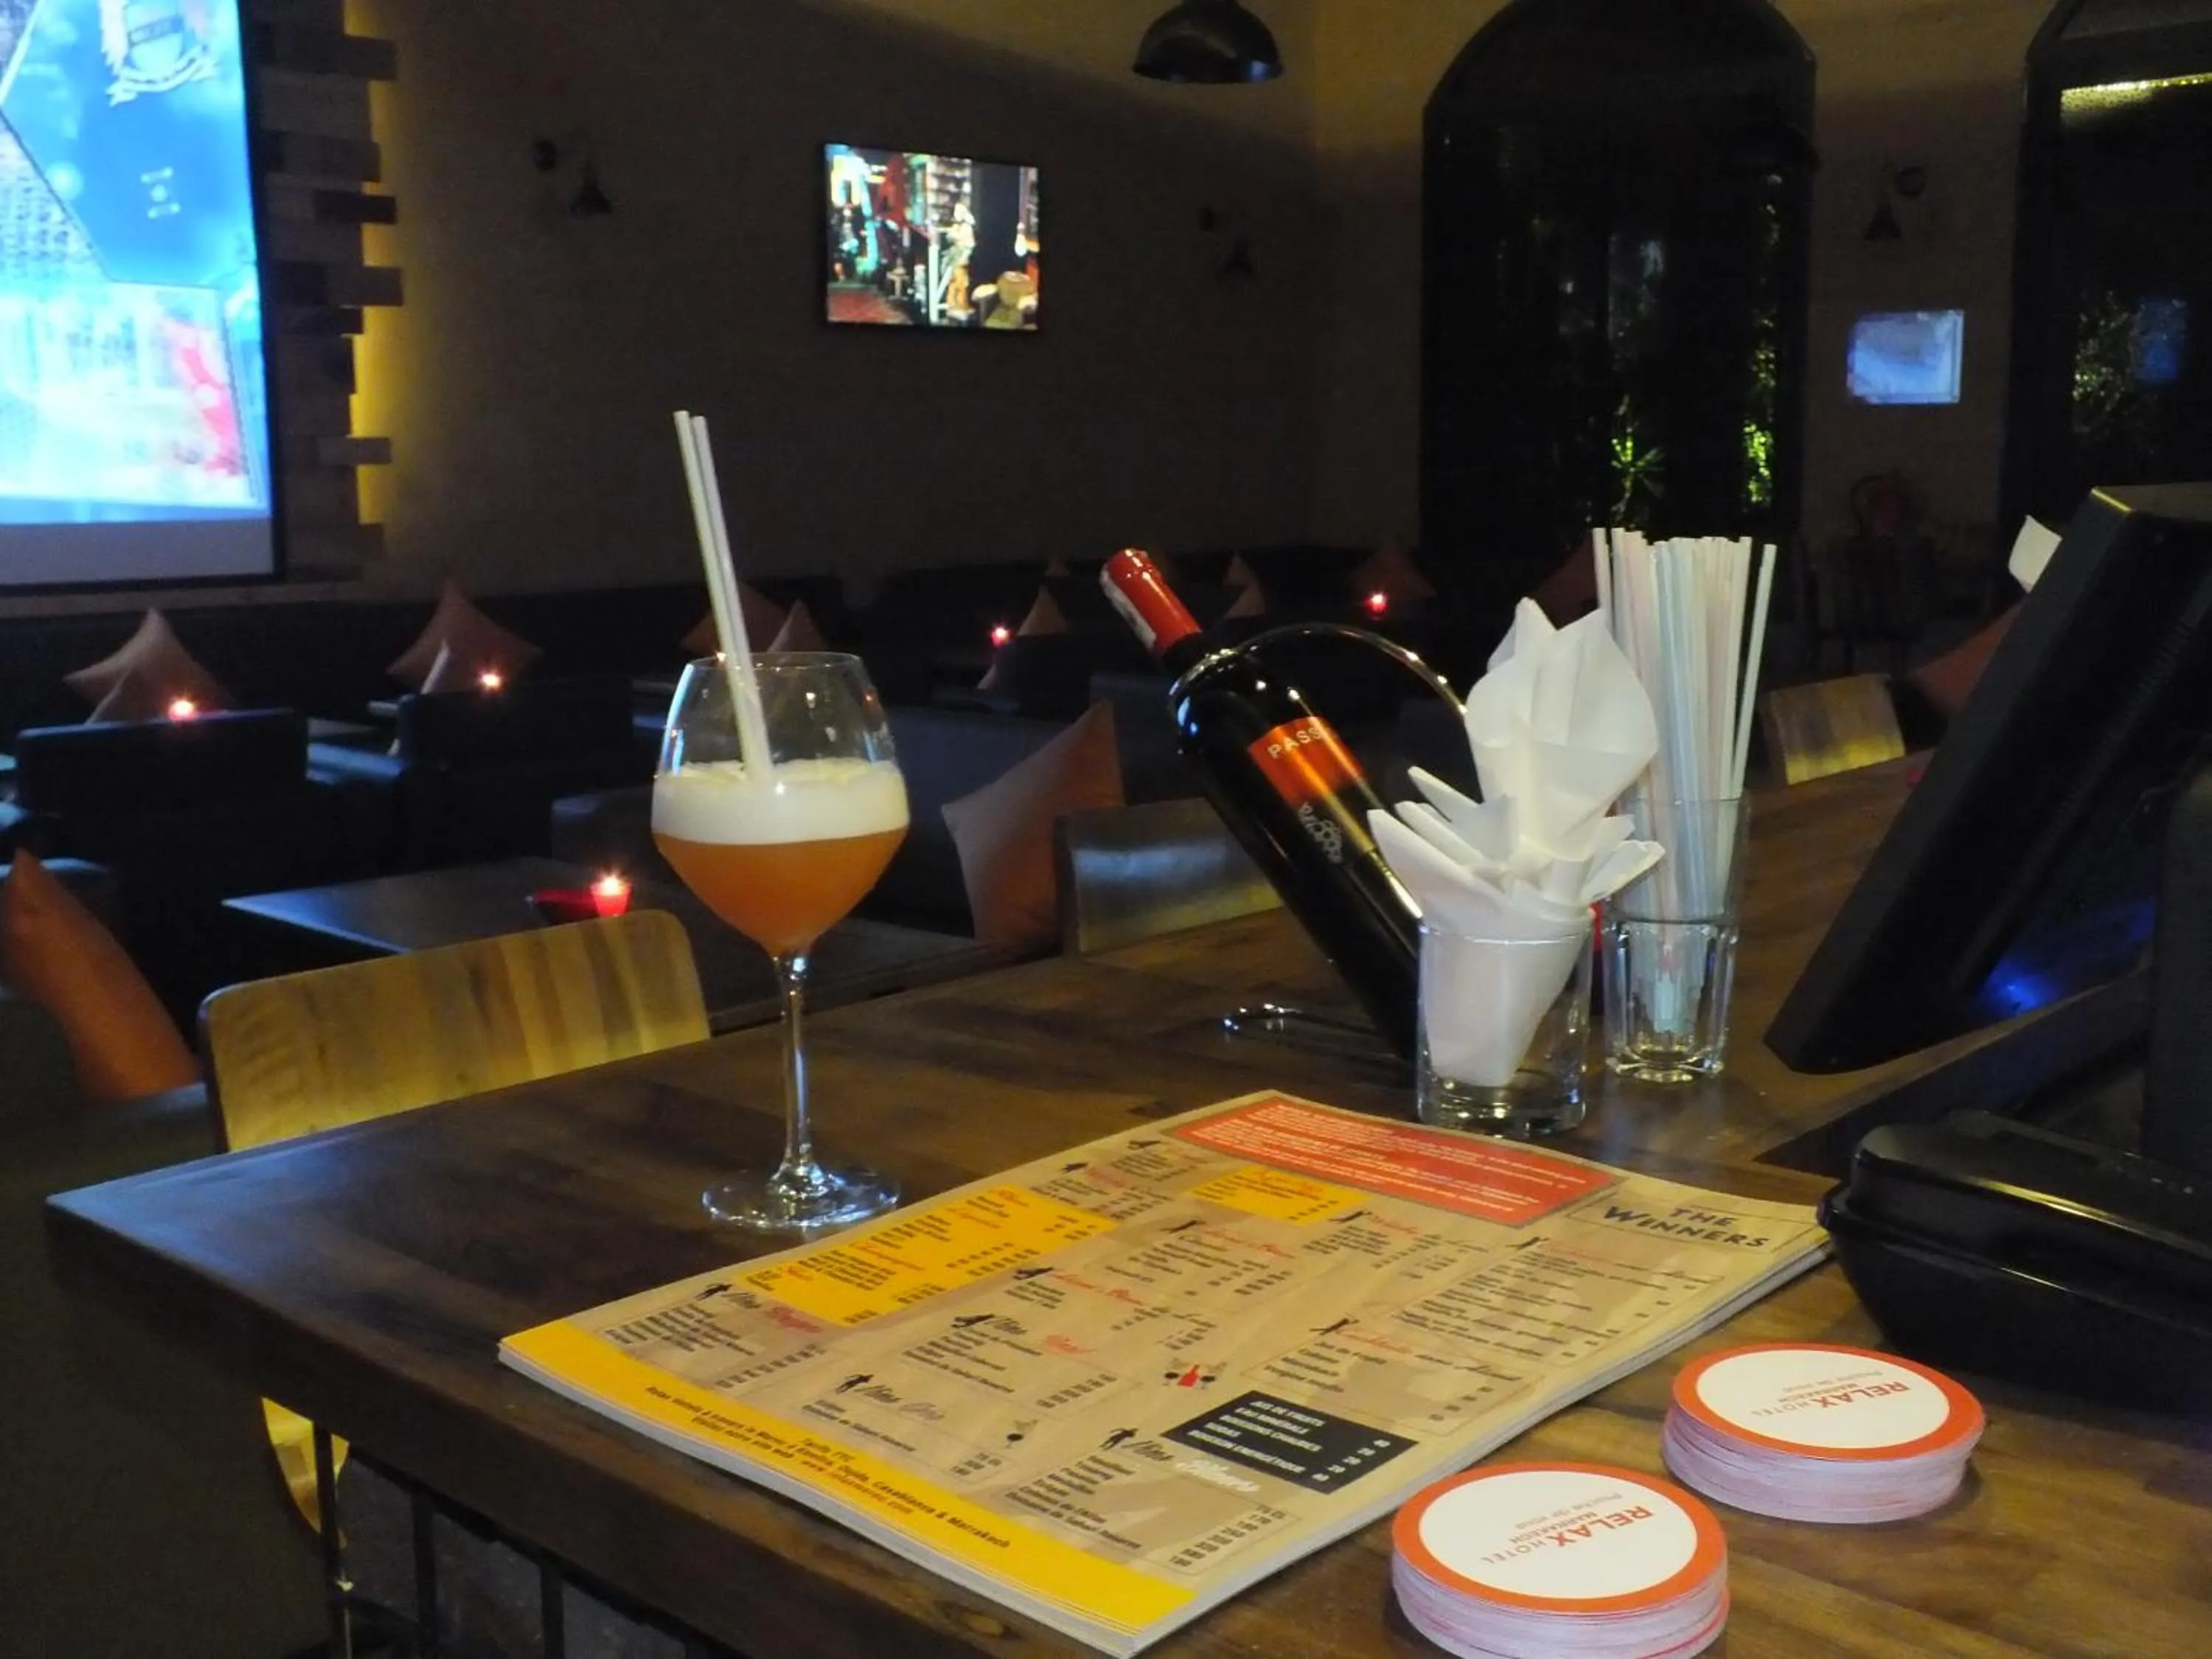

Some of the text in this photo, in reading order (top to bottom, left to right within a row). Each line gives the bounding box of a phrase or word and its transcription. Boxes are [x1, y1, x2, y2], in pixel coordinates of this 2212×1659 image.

[1604, 1206, 1770, 1248] WINNERS
[1669, 1207, 1737, 1227] THE
[1810, 1381, 1911, 1408] RELAX
[1750, 1401, 1810, 1417] HOTEL
[1545, 1506, 1653, 1547] RELAX
[1480, 1539, 1547, 1564] HOTEL
